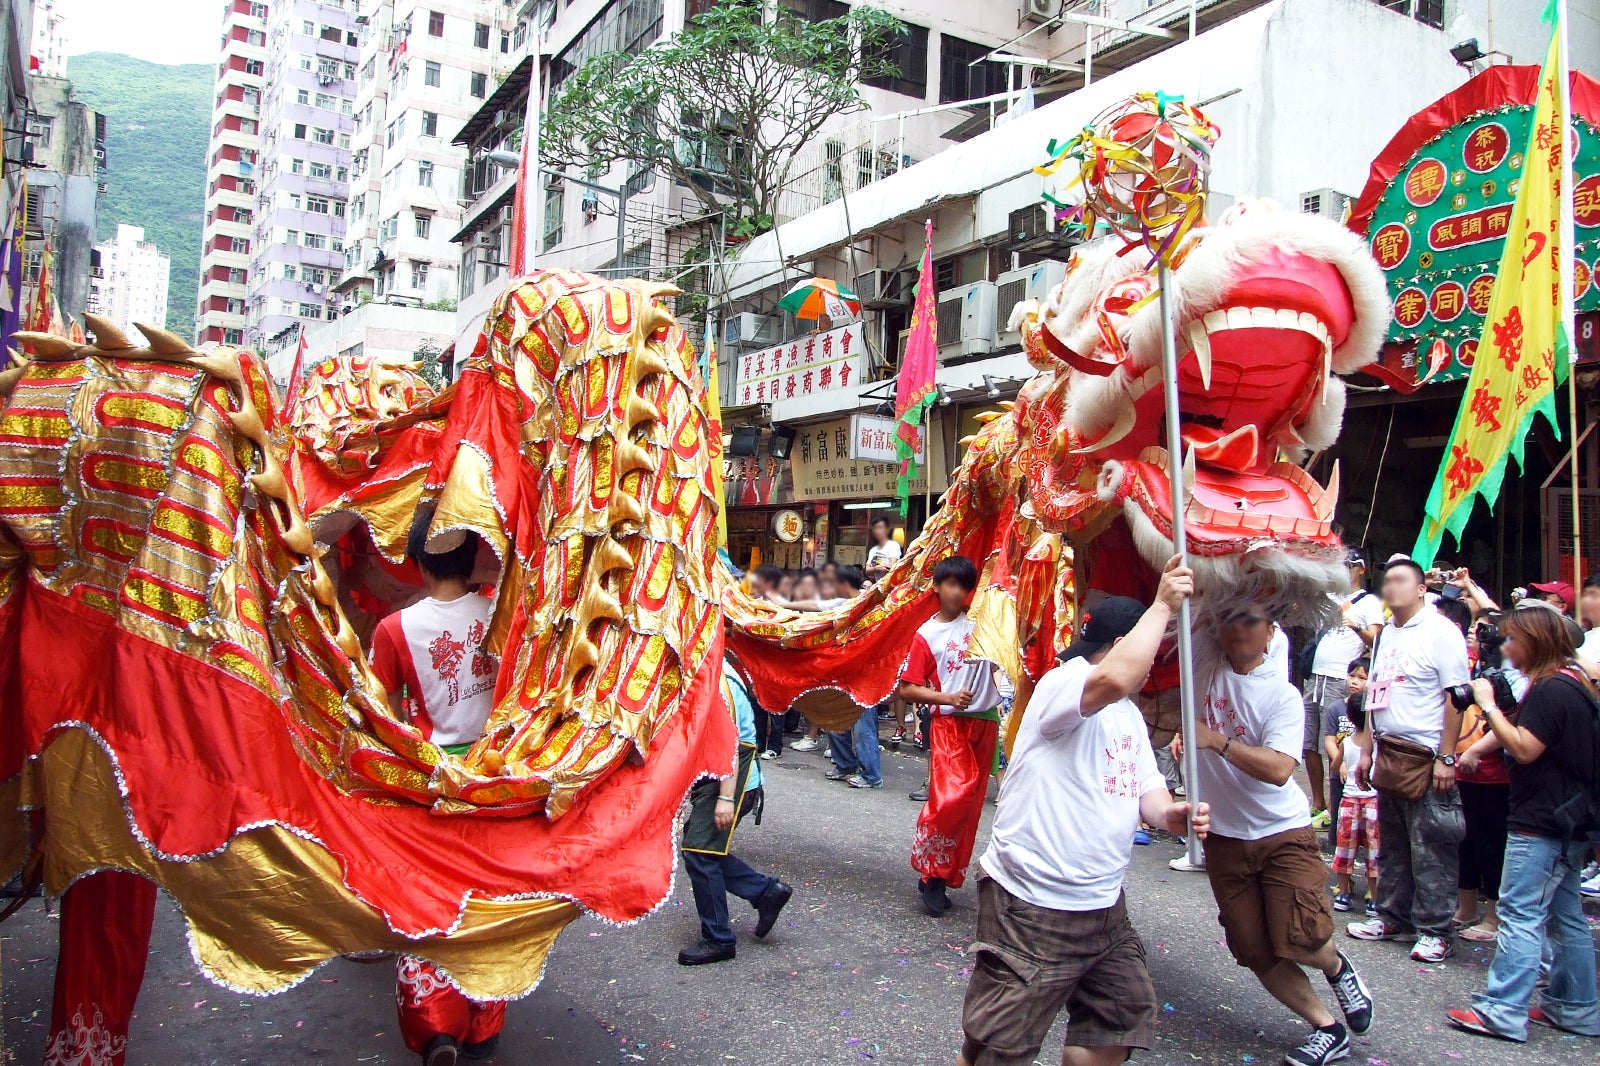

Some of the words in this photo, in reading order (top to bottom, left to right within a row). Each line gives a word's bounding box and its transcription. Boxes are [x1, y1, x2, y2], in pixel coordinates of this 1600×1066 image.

[1409, 165, 1446, 198] 譚
[1376, 229, 1404, 264] 寶
[744, 329, 853, 379] 筲箕灣漁業商會
[1372, 687, 1387, 703] 17
